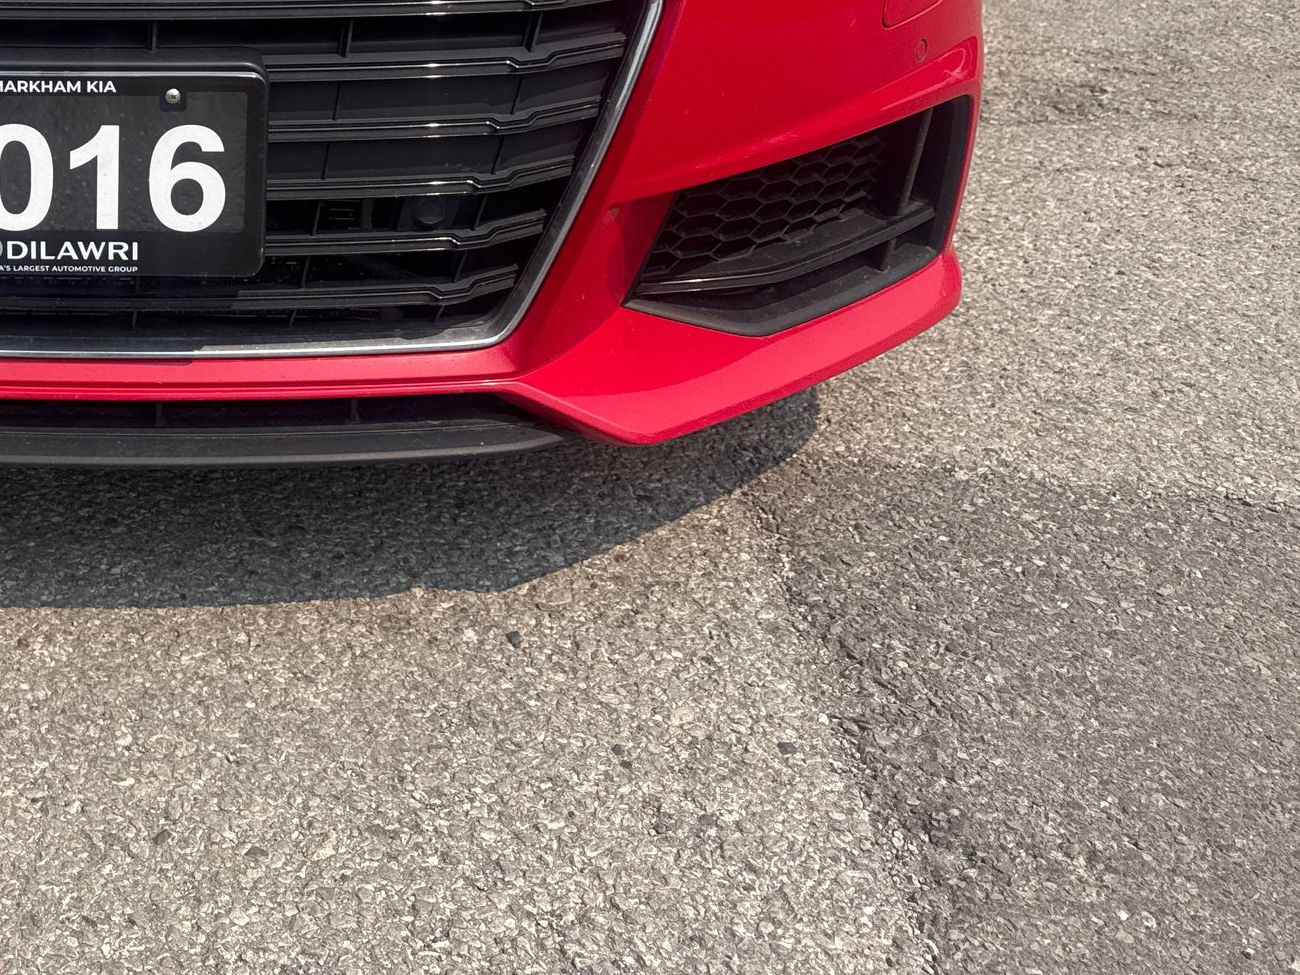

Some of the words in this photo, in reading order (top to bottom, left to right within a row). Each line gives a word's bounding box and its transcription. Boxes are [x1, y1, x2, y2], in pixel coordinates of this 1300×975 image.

[86, 80, 117, 93] KIA
[6, 240, 139, 261] DILAWRI
[13, 264, 50, 272] LARGEST
[52, 265, 106, 273] AUTOMOTIVE
[107, 265, 139, 273] GROUP
